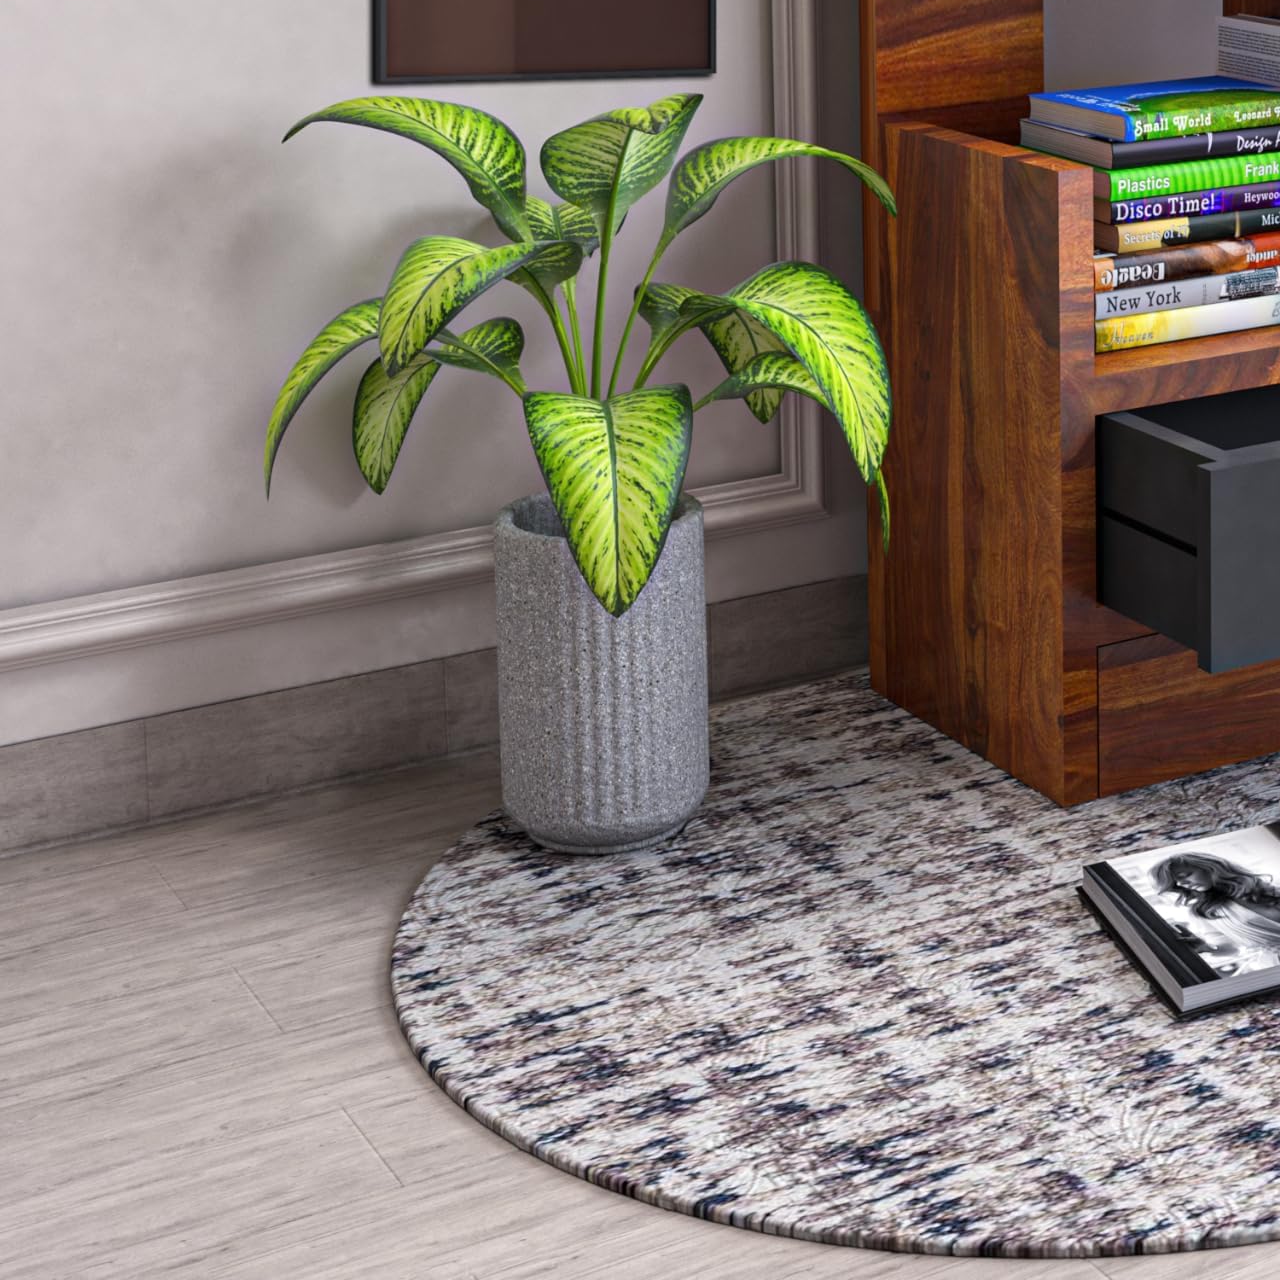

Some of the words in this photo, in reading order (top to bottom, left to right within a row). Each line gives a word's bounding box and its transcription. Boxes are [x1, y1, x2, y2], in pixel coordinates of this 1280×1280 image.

[1233, 108, 1272, 122] Leonard
[1134, 118, 1168, 137] Small
[1173, 112, 1212, 131] World
[1236, 135, 1272, 153] Design
[1245, 161, 1280, 177] Frank
[1118, 176, 1170, 194] Plastics
[1116, 201, 1162, 220] Disco
[1168, 193, 1215, 214] Time!
[1123, 232, 1161, 245] Secrets
[1100, 262, 1165, 285] Beagle
[1106, 297, 1144, 313] New
[1145, 285, 1182, 307] York
